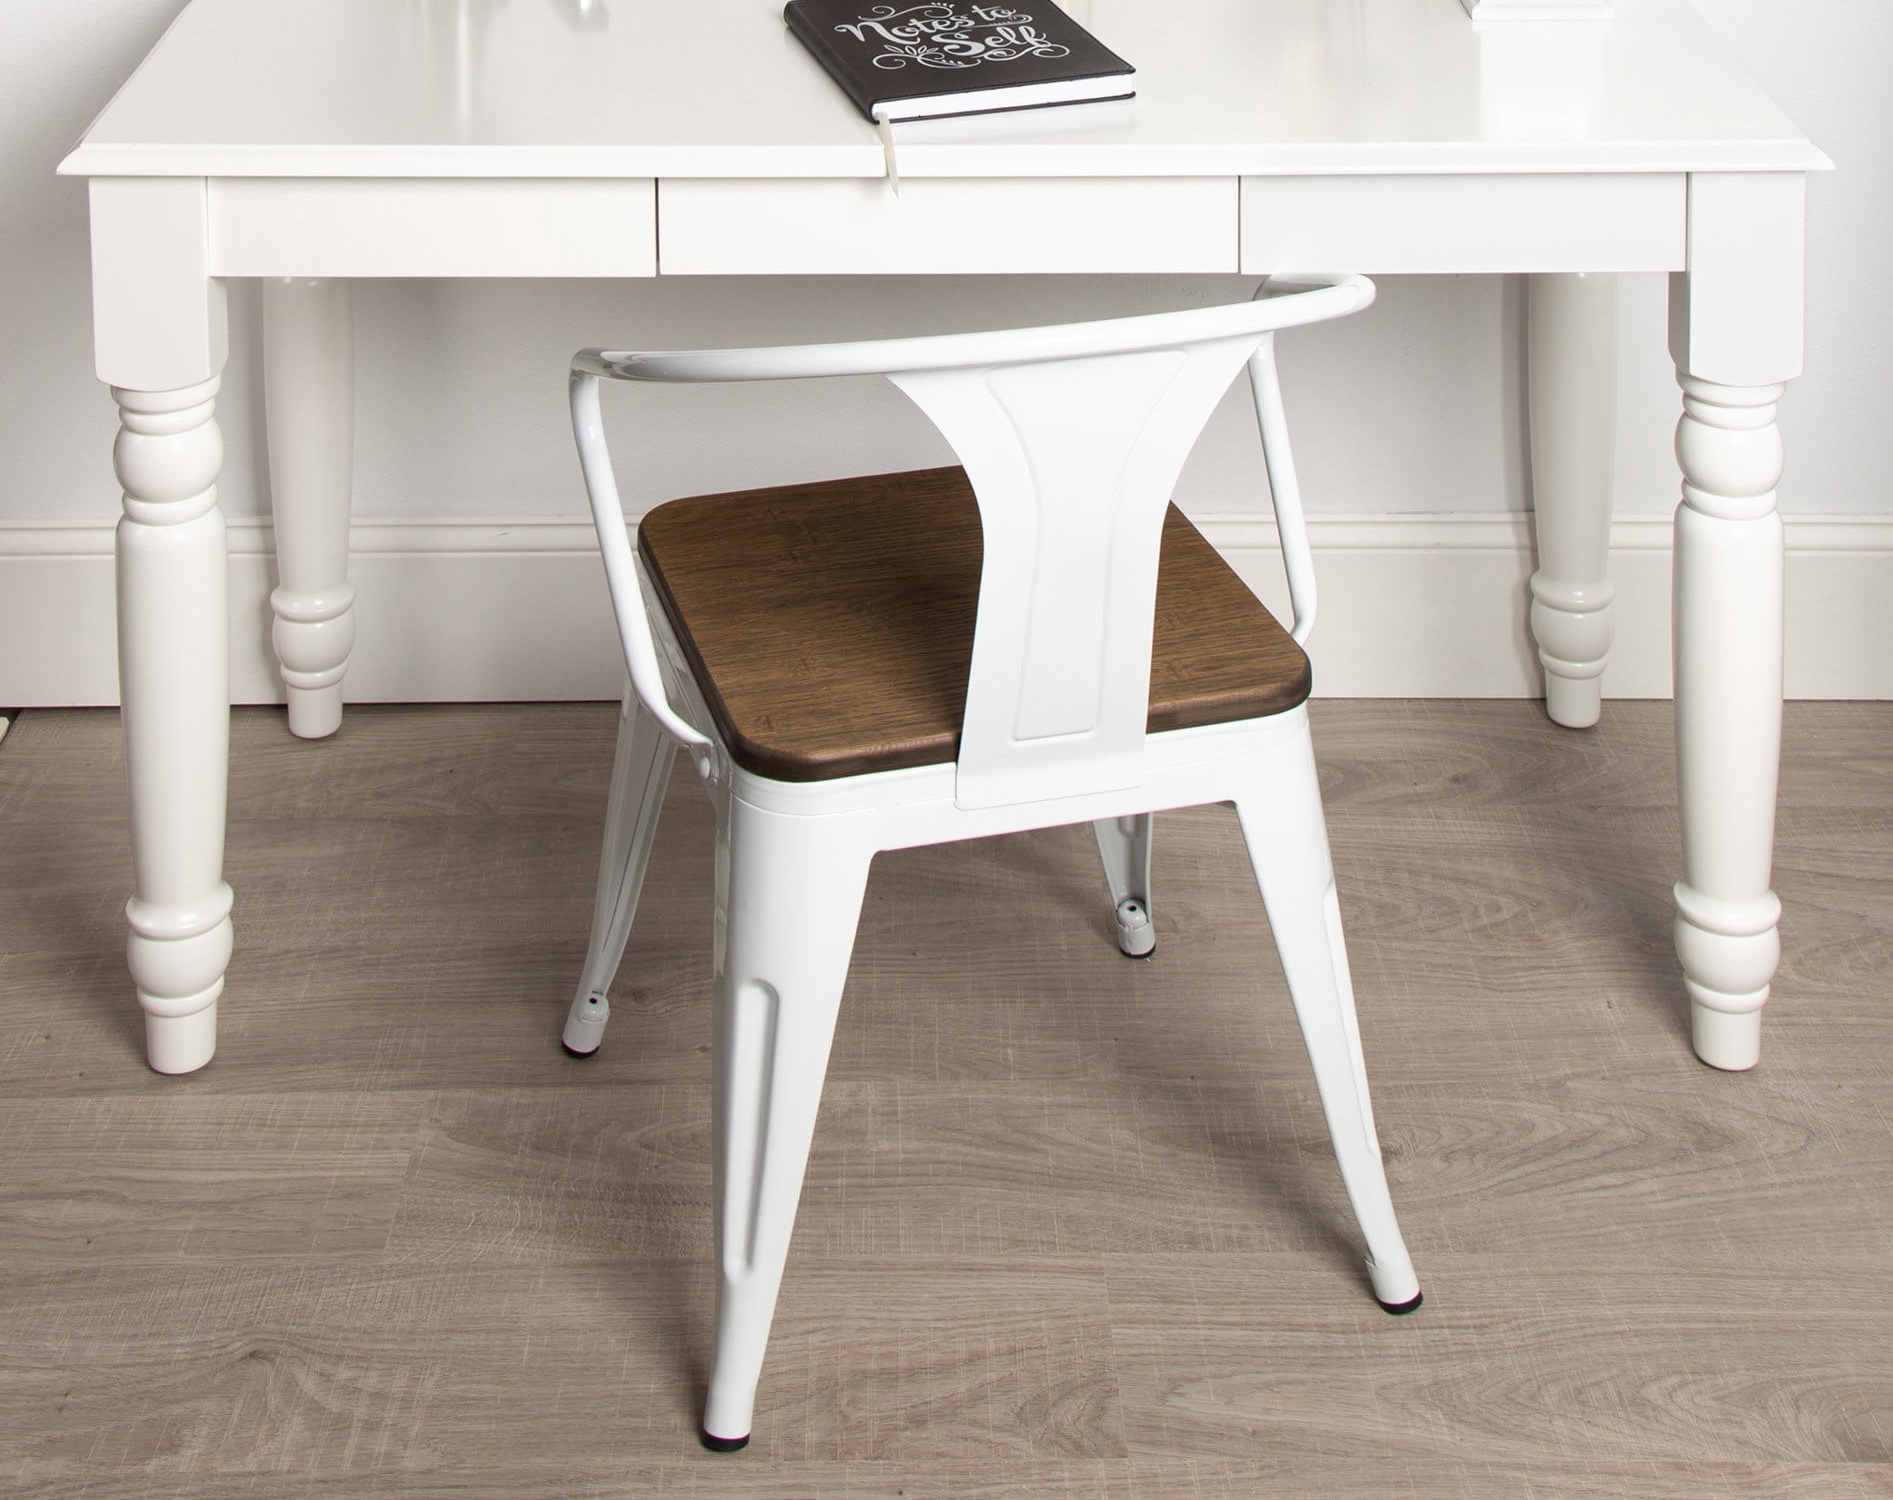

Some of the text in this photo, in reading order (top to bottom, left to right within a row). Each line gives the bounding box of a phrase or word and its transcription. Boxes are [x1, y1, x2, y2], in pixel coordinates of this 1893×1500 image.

[834, 4, 1016, 45] Notes to
[931, 25, 1058, 57] Self
